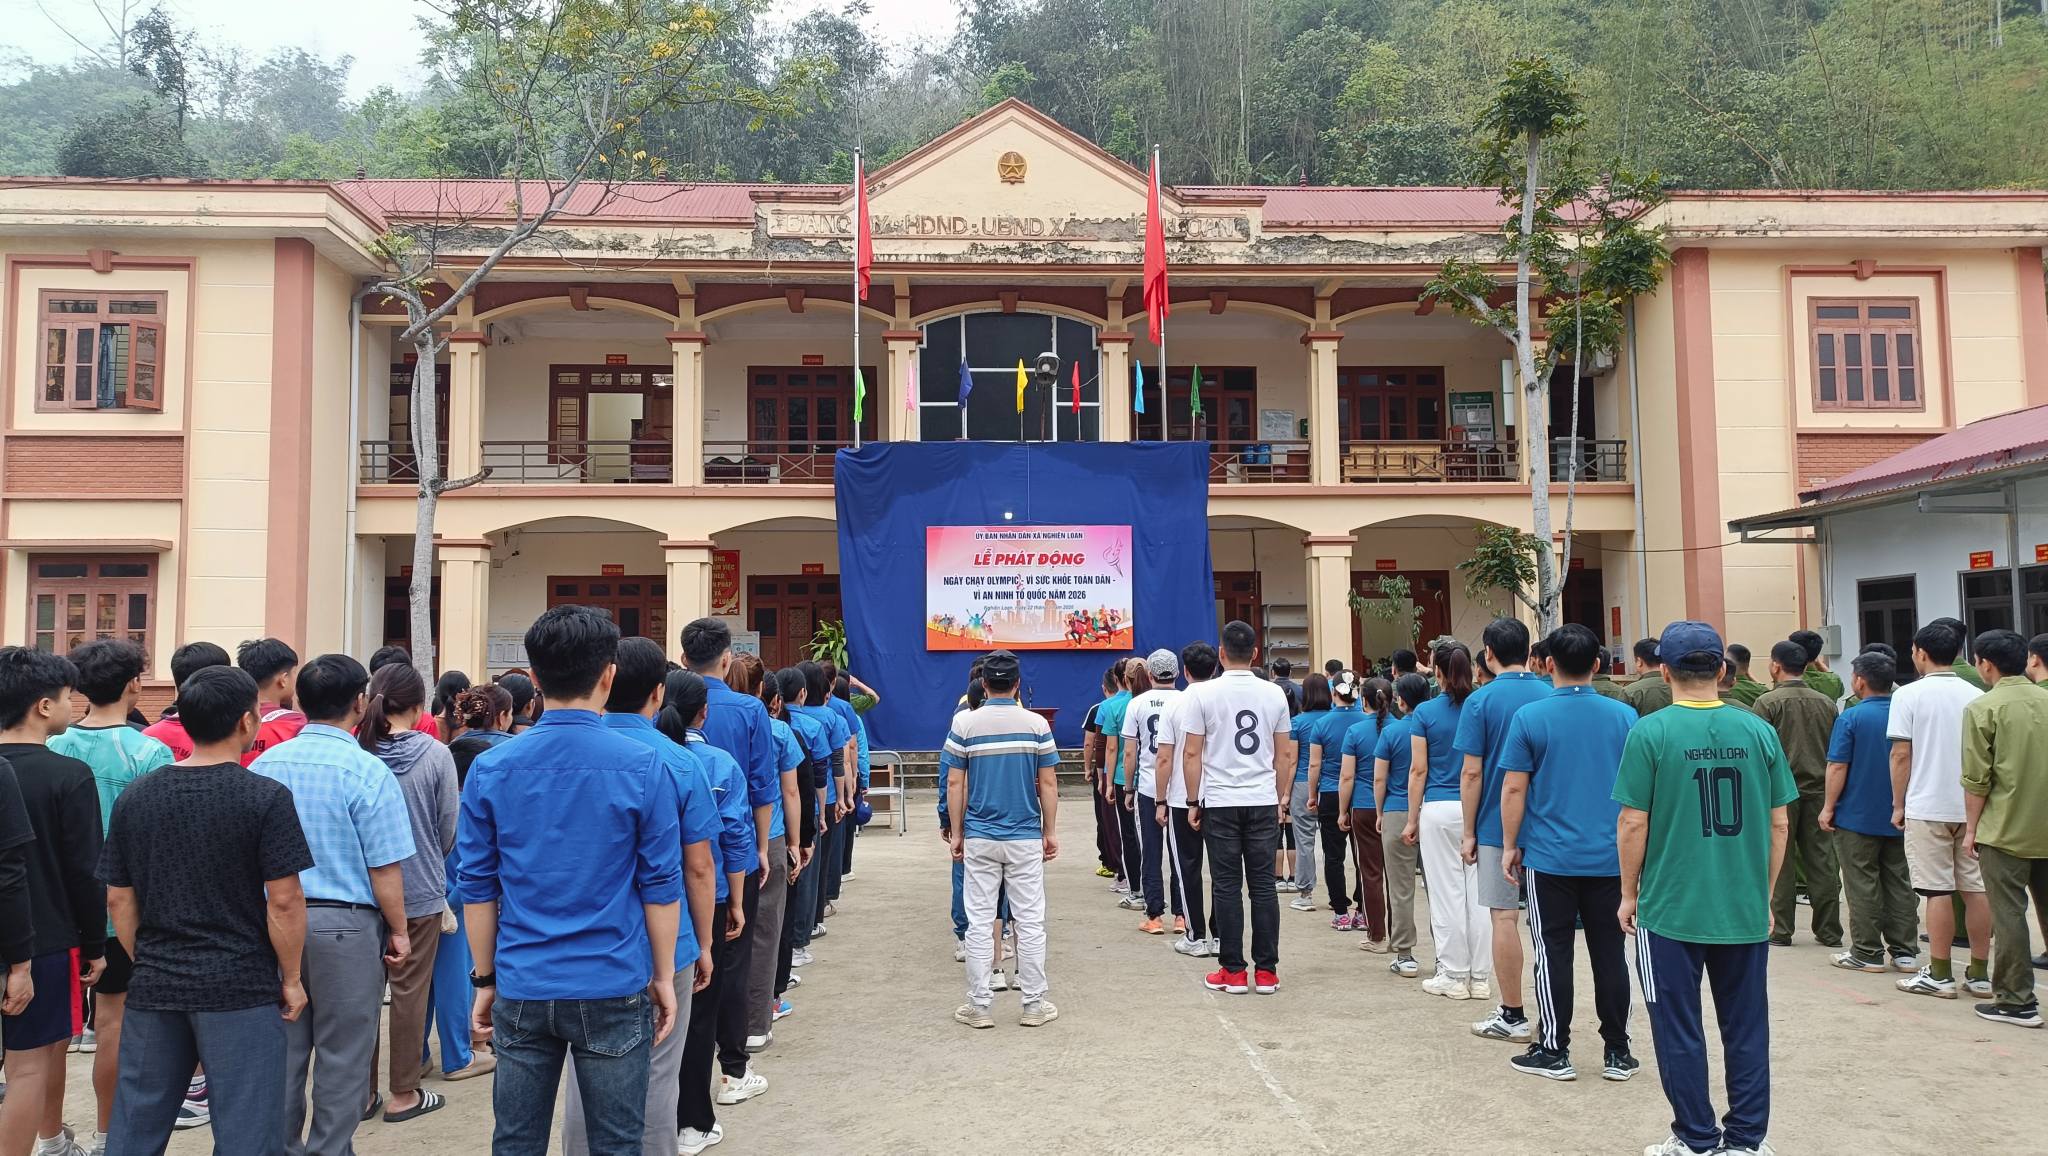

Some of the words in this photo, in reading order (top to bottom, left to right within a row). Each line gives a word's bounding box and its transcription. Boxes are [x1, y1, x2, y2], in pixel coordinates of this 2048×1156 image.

[981, 216, 1045, 237] UBND
[985, 532, 998, 540] BAN
[974, 548, 992, 566] LỄ
[994, 550, 1035, 566] PHÁT
[1038, 550, 1085, 568] ĐỘNG
[943, 575, 964, 586] NGÀY
[965, 576, 985, 587] CHẠY
[987, 576, 1019, 586] OLYMPIC
[1026, 574, 1033, 585] VÌ
[1035, 574, 1050, 585] SỨC
[1052, 573, 1072, 585] KHỎE
[1073, 574, 1094, 585] TOÀN
[1095, 574, 1111, 585] DÂN
[973, 589, 981, 600] VÌ
[982, 591, 993, 600] AN
[995, 591, 1014, 600] NINH
[1026, 588, 1047, 600] QUỐC
[1048, 589, 1066, 600] NĂM
[1068, 590, 1087, 600] 2026
[1234, 709, 1260, 756] 8
[1720, 747, 1749, 760] LOAN
[1692, 766, 1743, 838] 10
